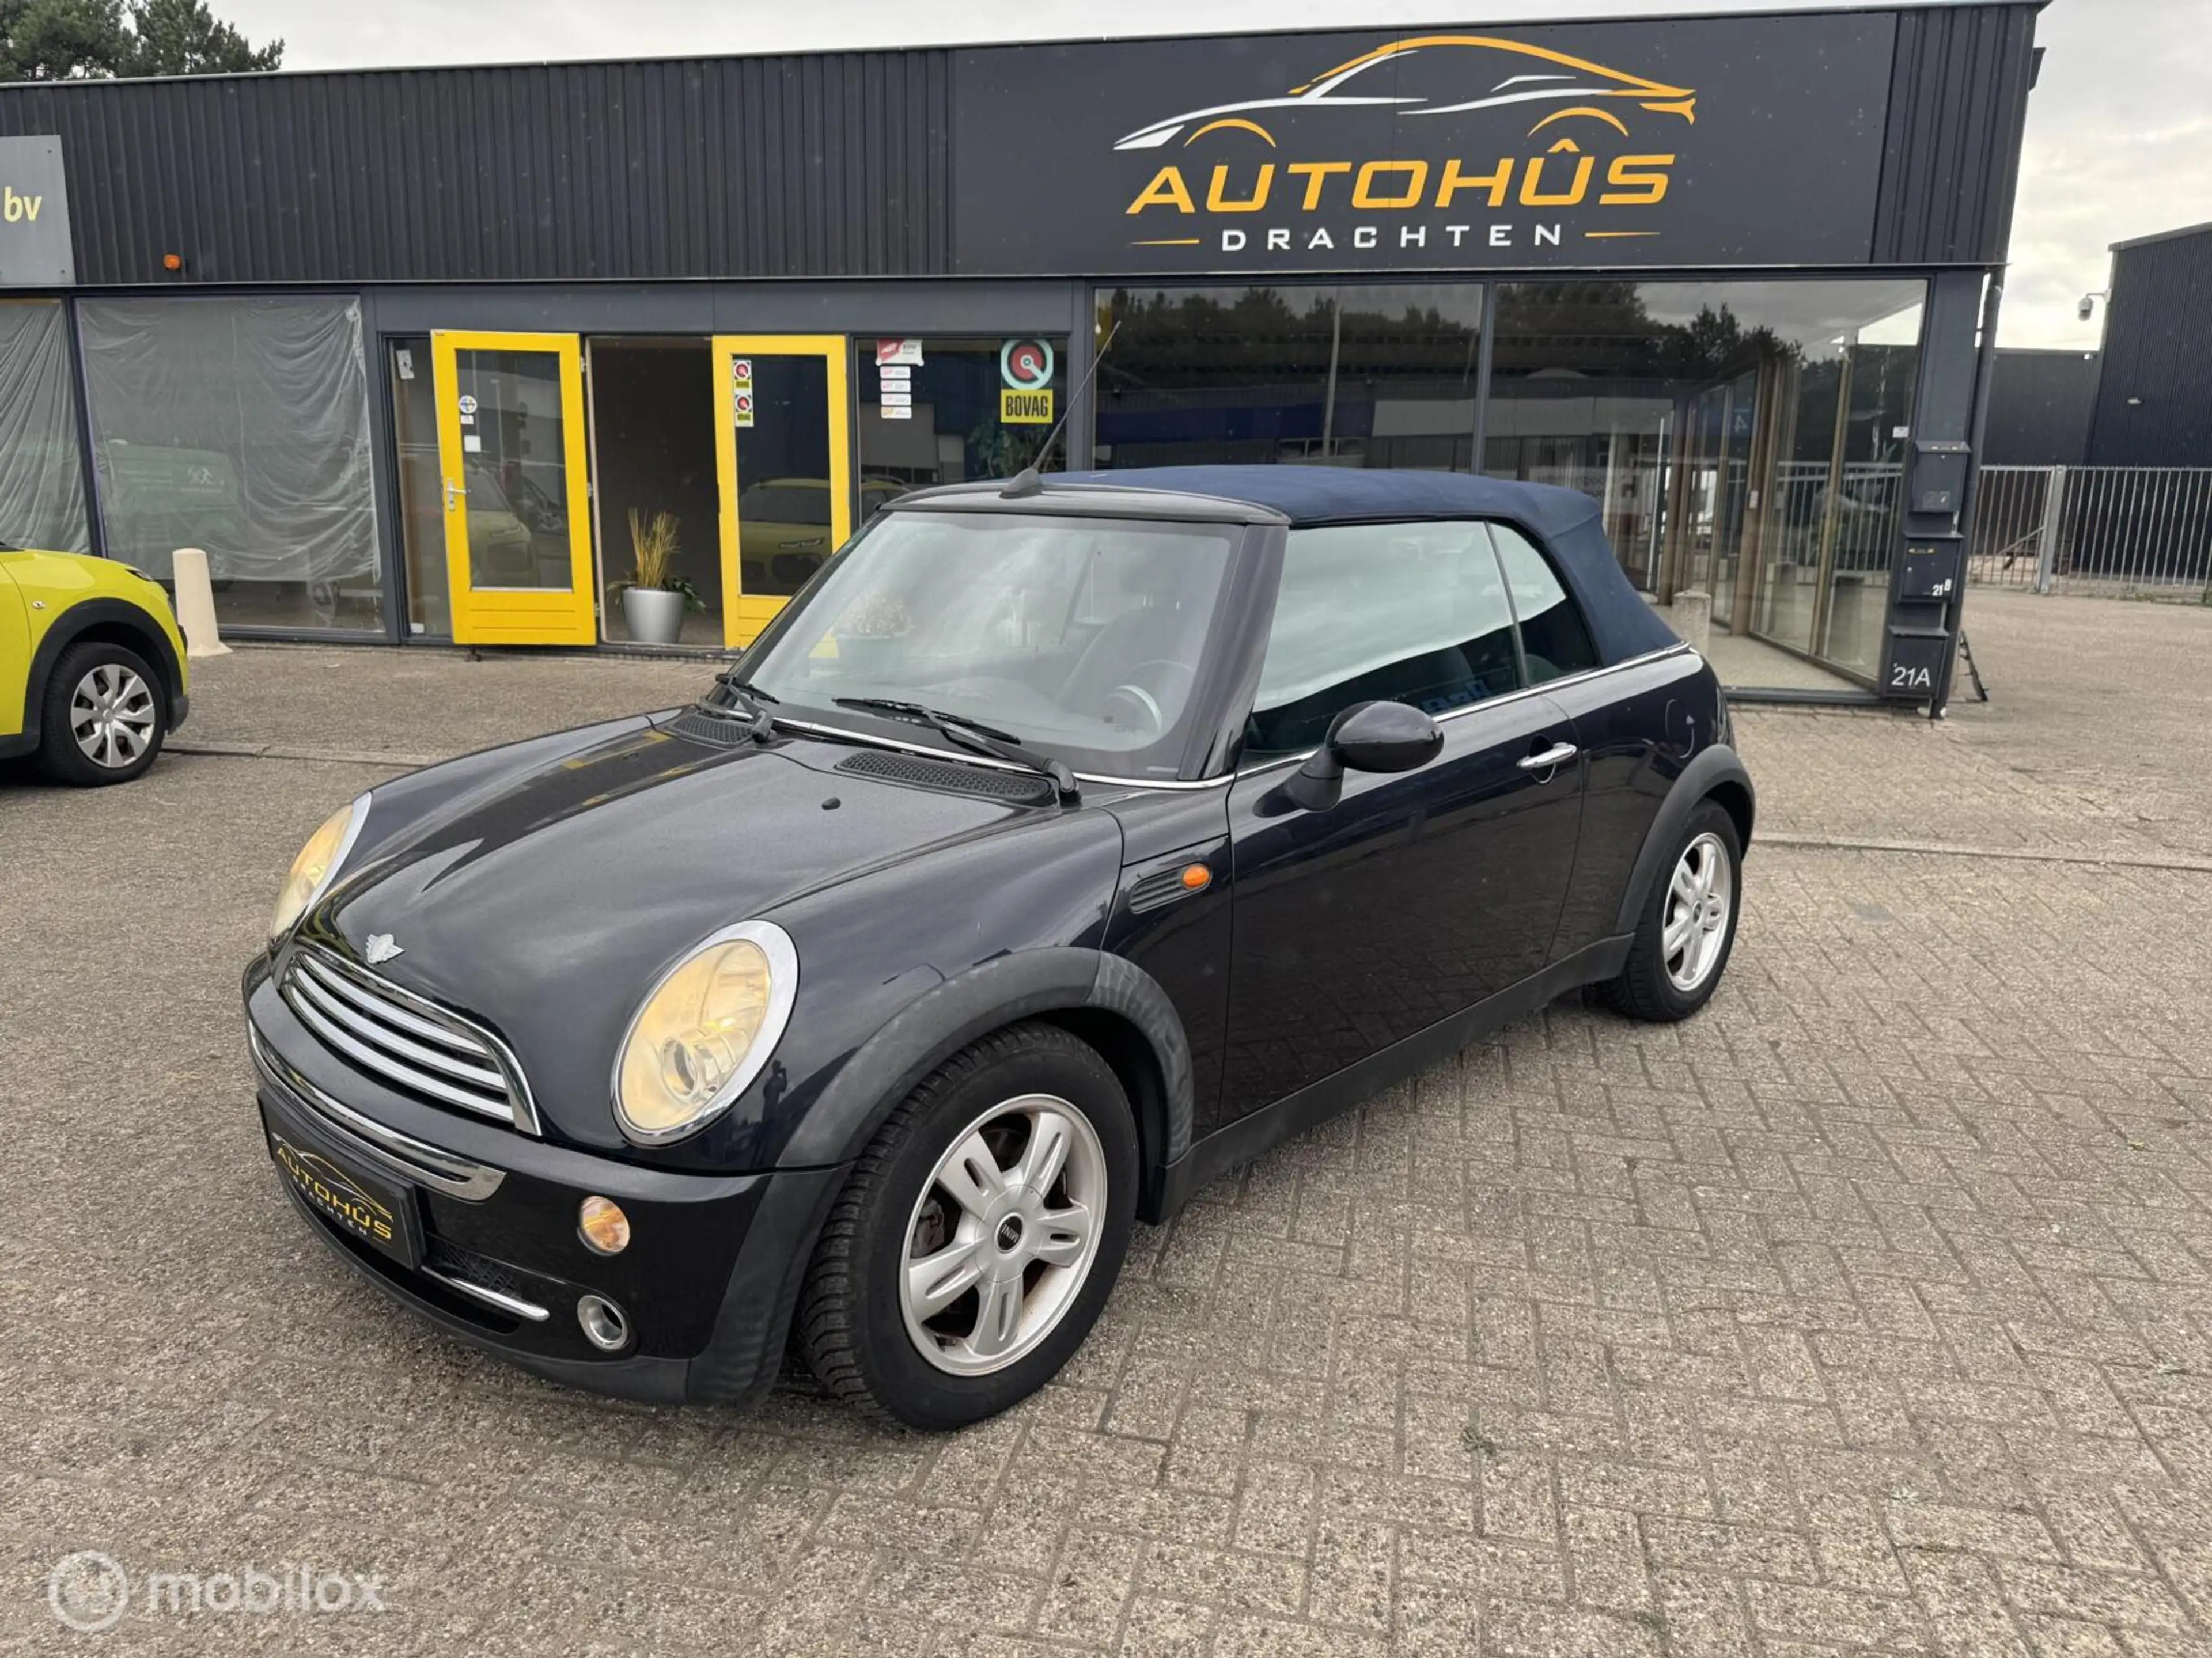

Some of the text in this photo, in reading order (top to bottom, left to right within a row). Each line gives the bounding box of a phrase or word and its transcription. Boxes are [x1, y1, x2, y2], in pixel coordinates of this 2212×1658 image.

[1126, 138, 1675, 214] AUTOHÛS
[4, 186, 42, 222] bv
[1222, 223, 1561, 251] DRACHTEN
[1006, 395, 1048, 416] BOVAG
[1891, 667, 1930, 687] 21A
